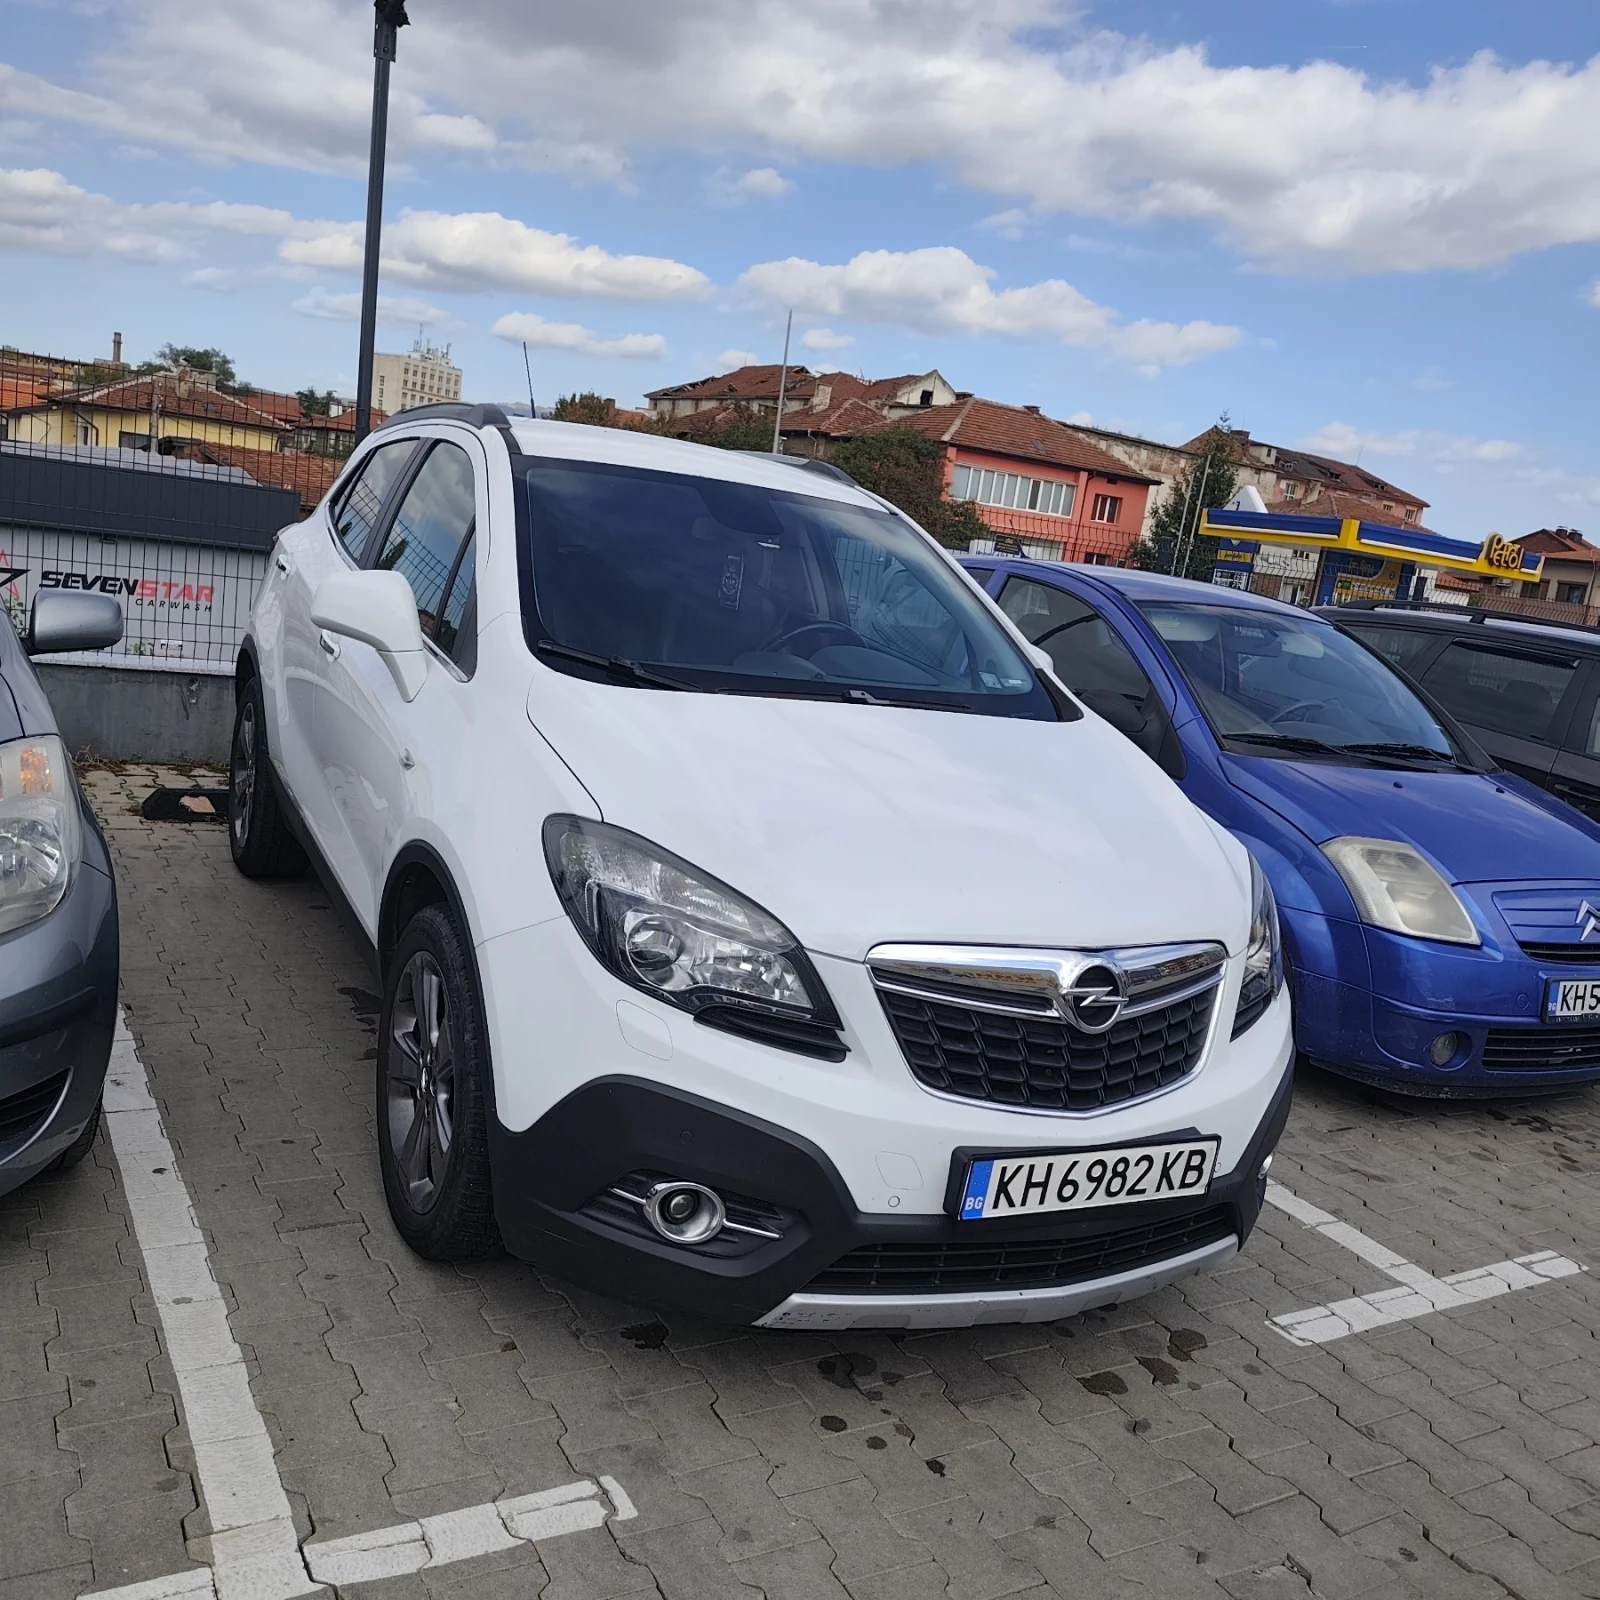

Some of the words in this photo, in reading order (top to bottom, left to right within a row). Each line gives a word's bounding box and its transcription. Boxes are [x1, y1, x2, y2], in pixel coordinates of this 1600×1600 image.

[39, 570, 215, 604] SEVENSTAR
[135, 598, 212, 612] CARWASH
[992, 1148, 1207, 1210] KH6982KB
[964, 1195, 983, 1212] BG
